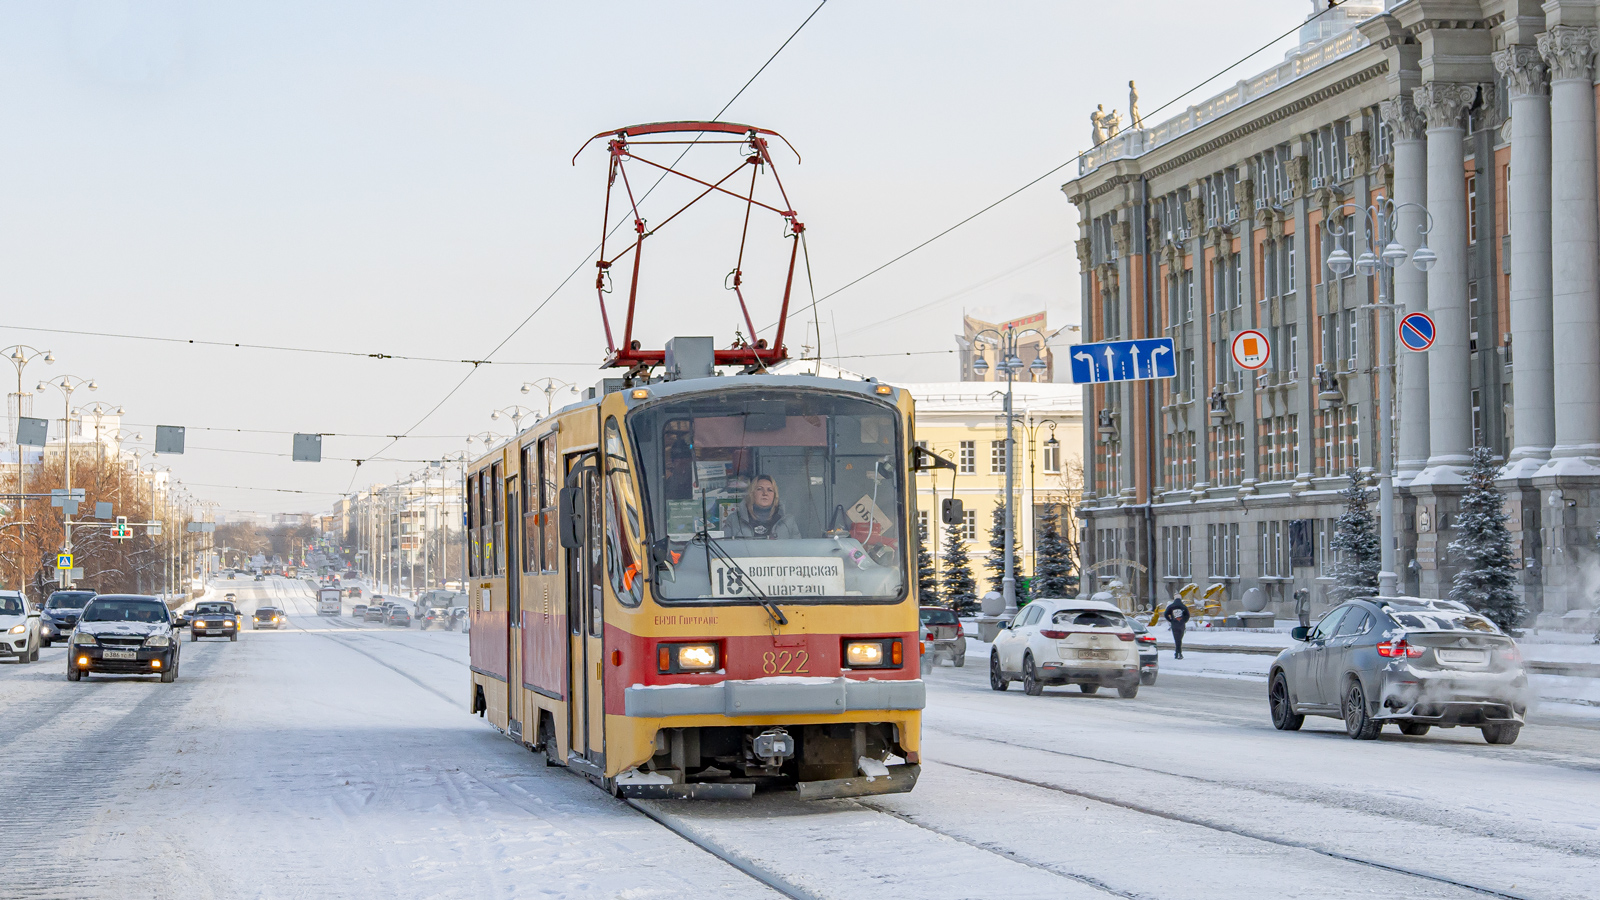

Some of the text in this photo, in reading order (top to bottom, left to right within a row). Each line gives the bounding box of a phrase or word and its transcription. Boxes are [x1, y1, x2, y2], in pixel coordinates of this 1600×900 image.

[716, 567, 744, 595] 18
[749, 565, 839, 578] ВОЛГОГРАДСКАЯ
[762, 650, 810, 674] 822
